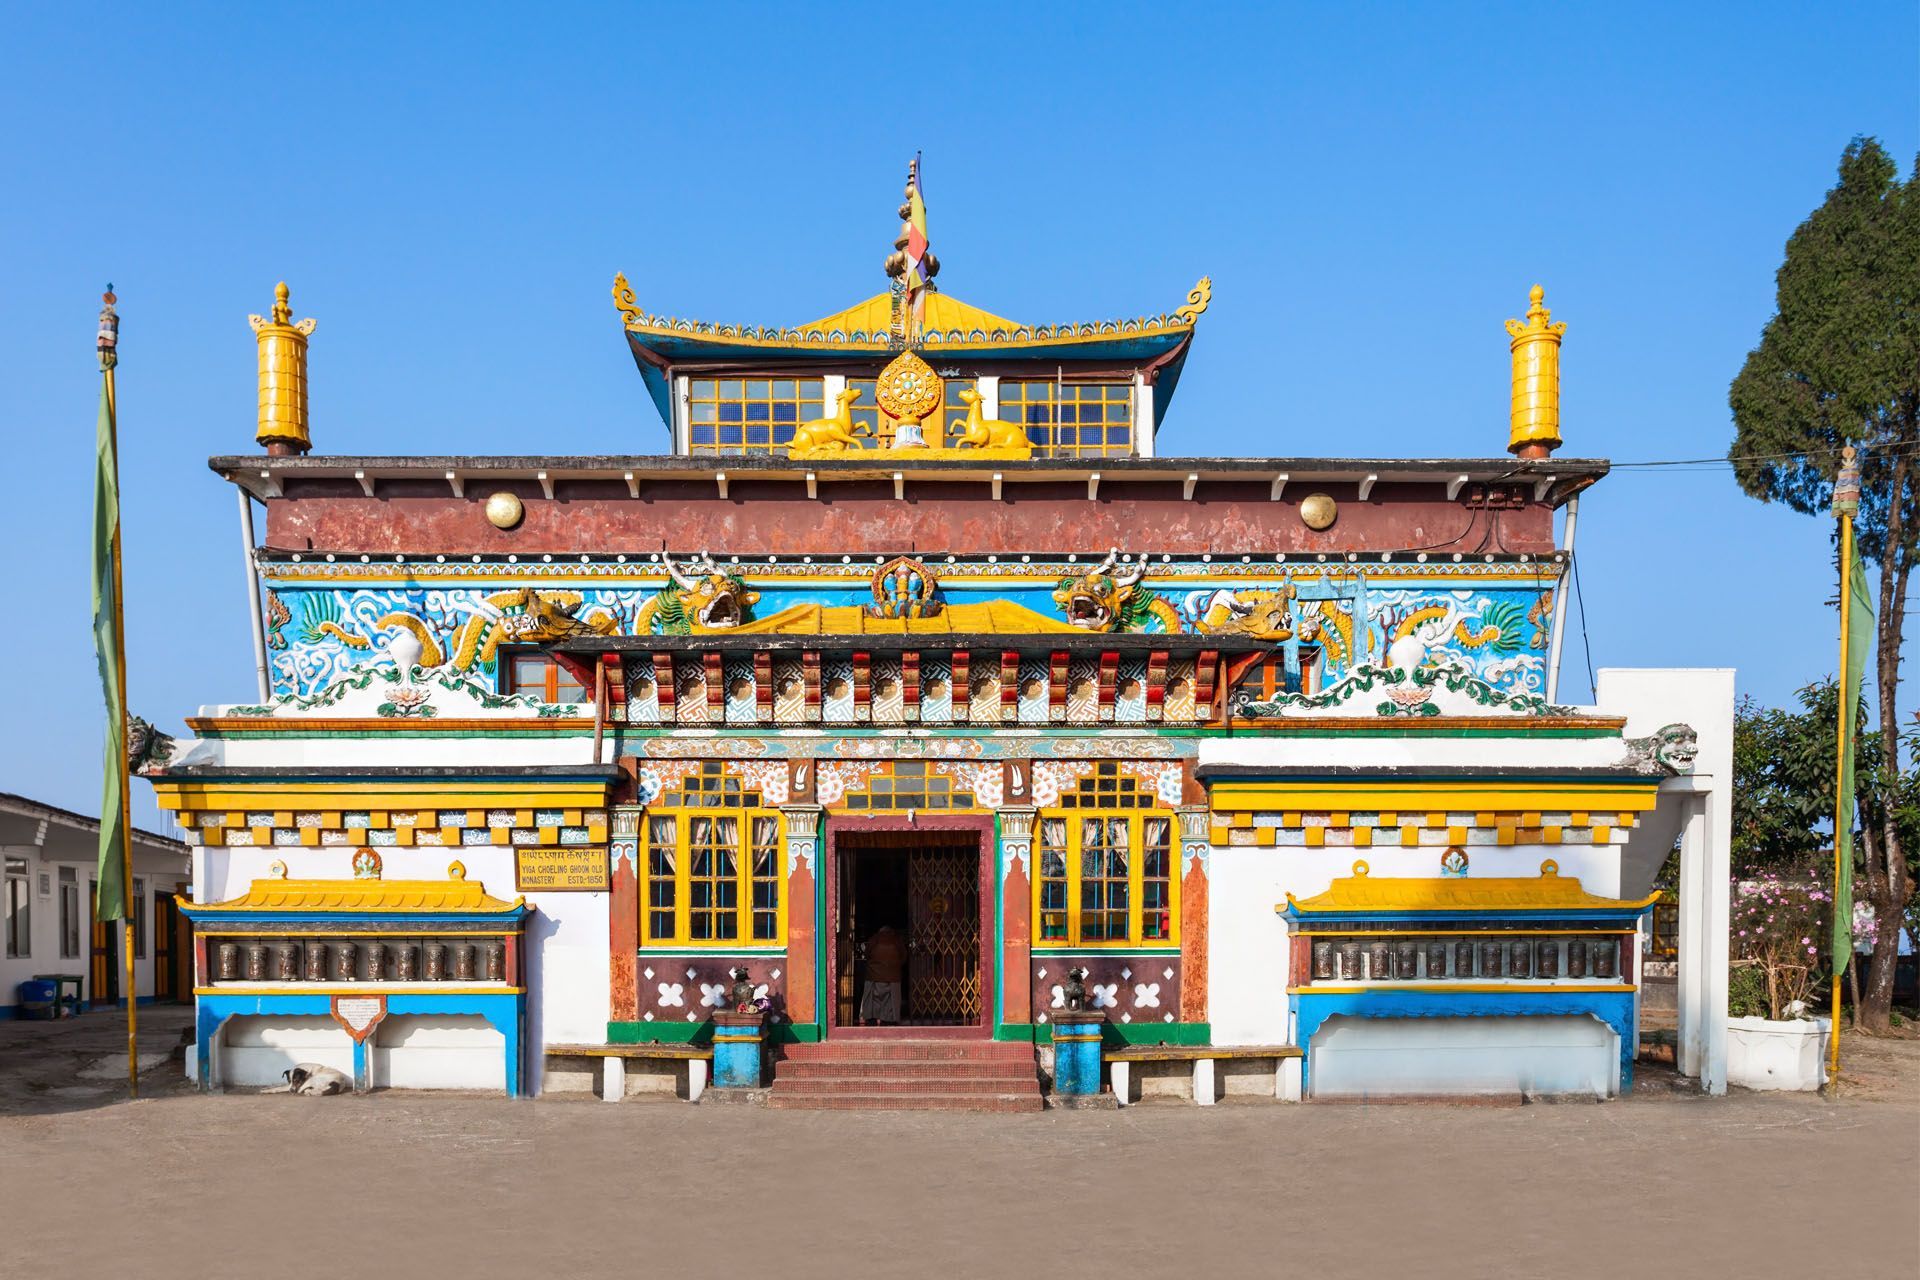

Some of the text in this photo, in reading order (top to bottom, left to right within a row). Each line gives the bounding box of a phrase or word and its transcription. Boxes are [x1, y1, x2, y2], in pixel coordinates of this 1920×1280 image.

[522, 865, 603, 874] YIGA CHOELING GHOOM OLD
[522, 876, 555, 884] MONASTERY
